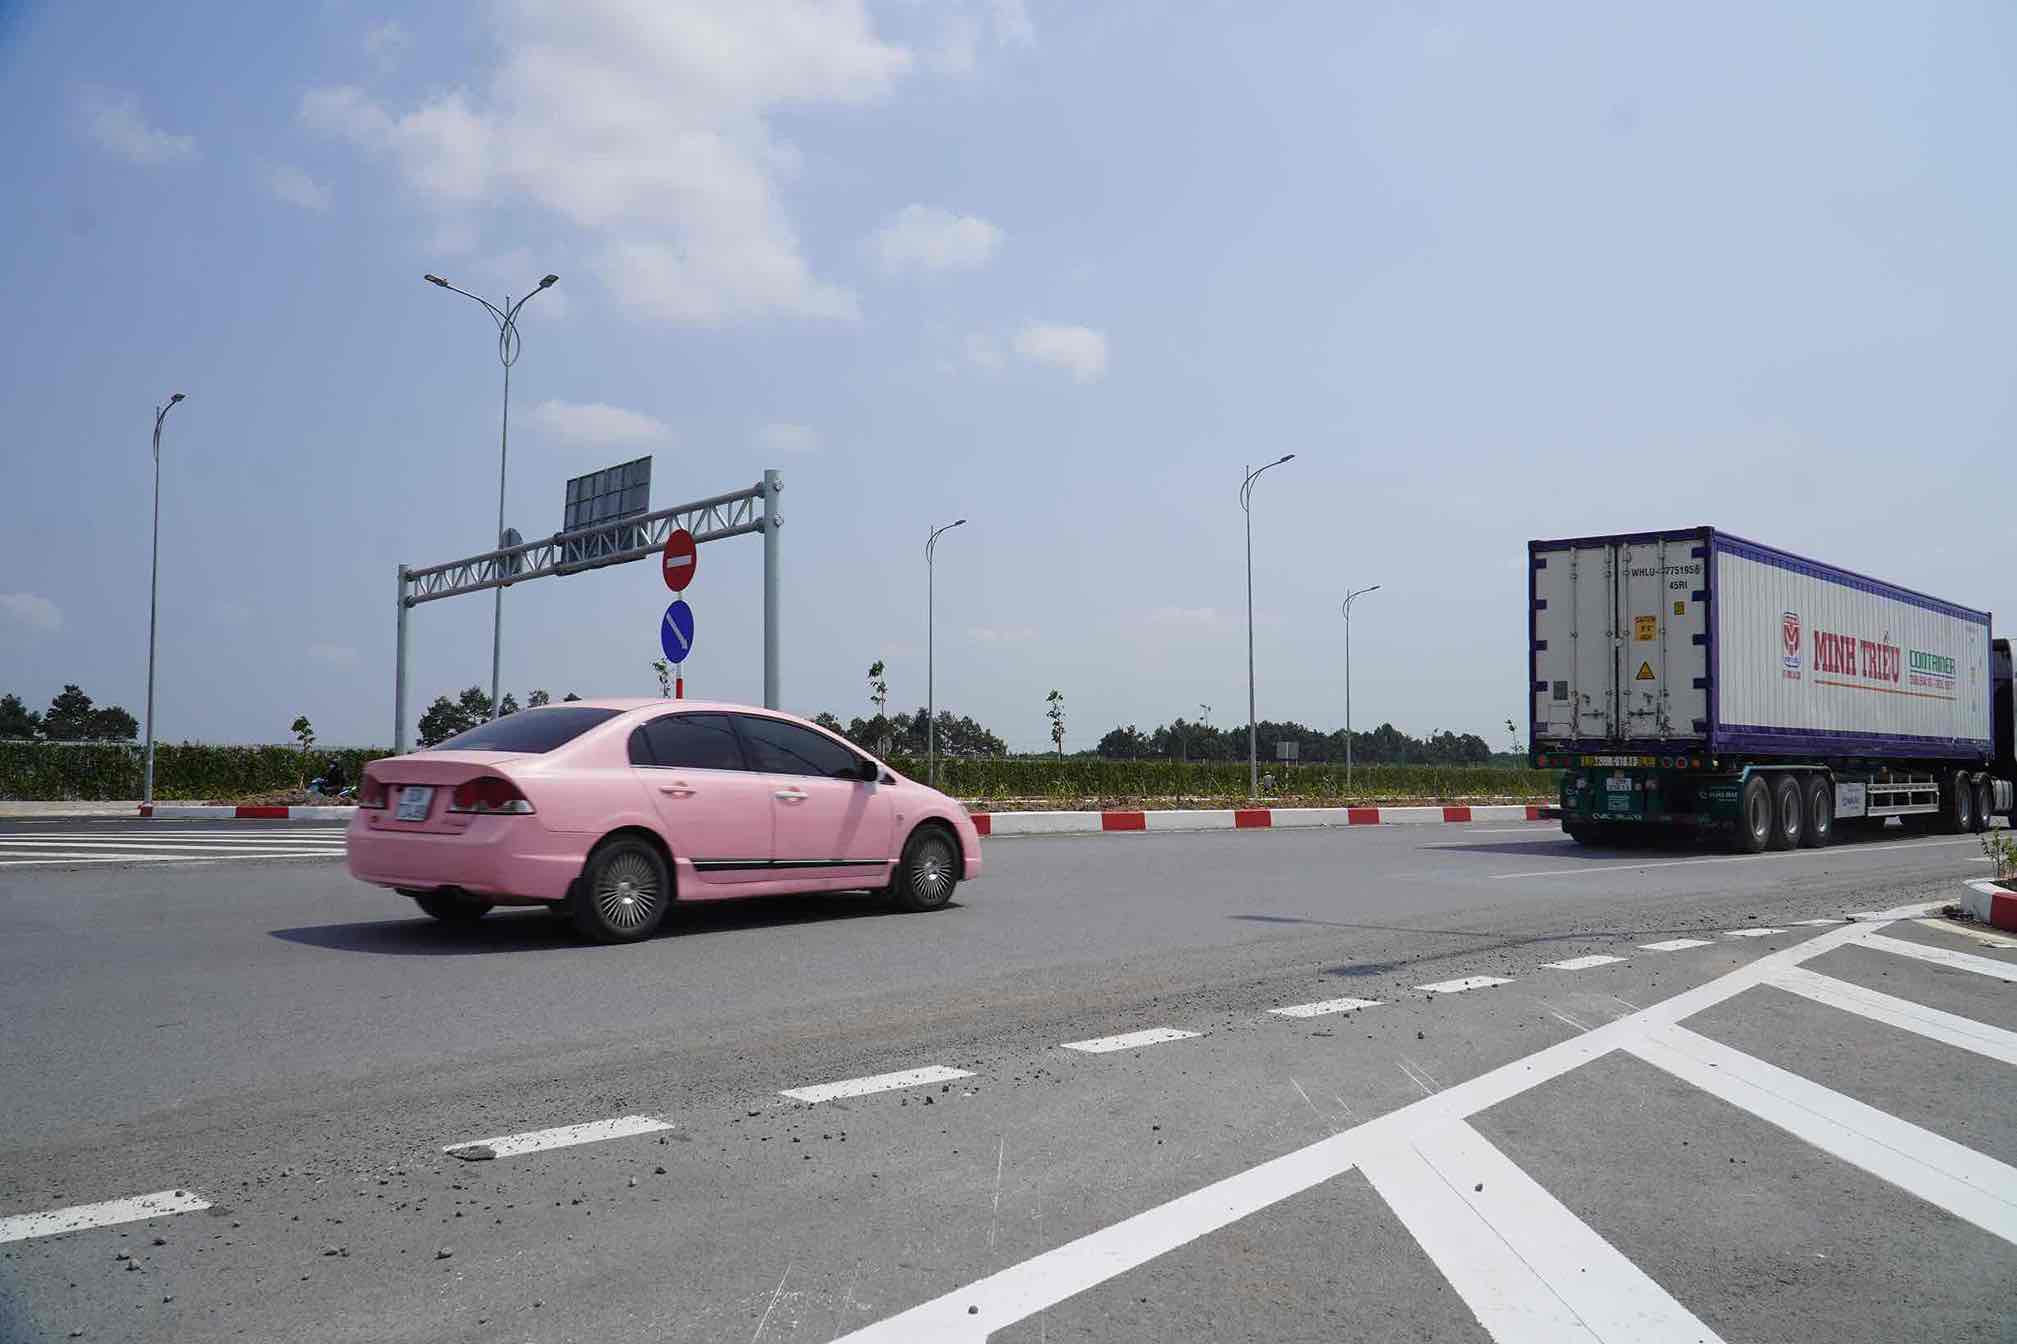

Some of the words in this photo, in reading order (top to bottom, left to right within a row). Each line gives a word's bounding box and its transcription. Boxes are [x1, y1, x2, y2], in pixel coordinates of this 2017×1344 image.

[1631, 567, 1656, 577] WHLU
[1813, 629, 1856, 676] MINH
[1909, 649, 1956, 675] CONTAINER
